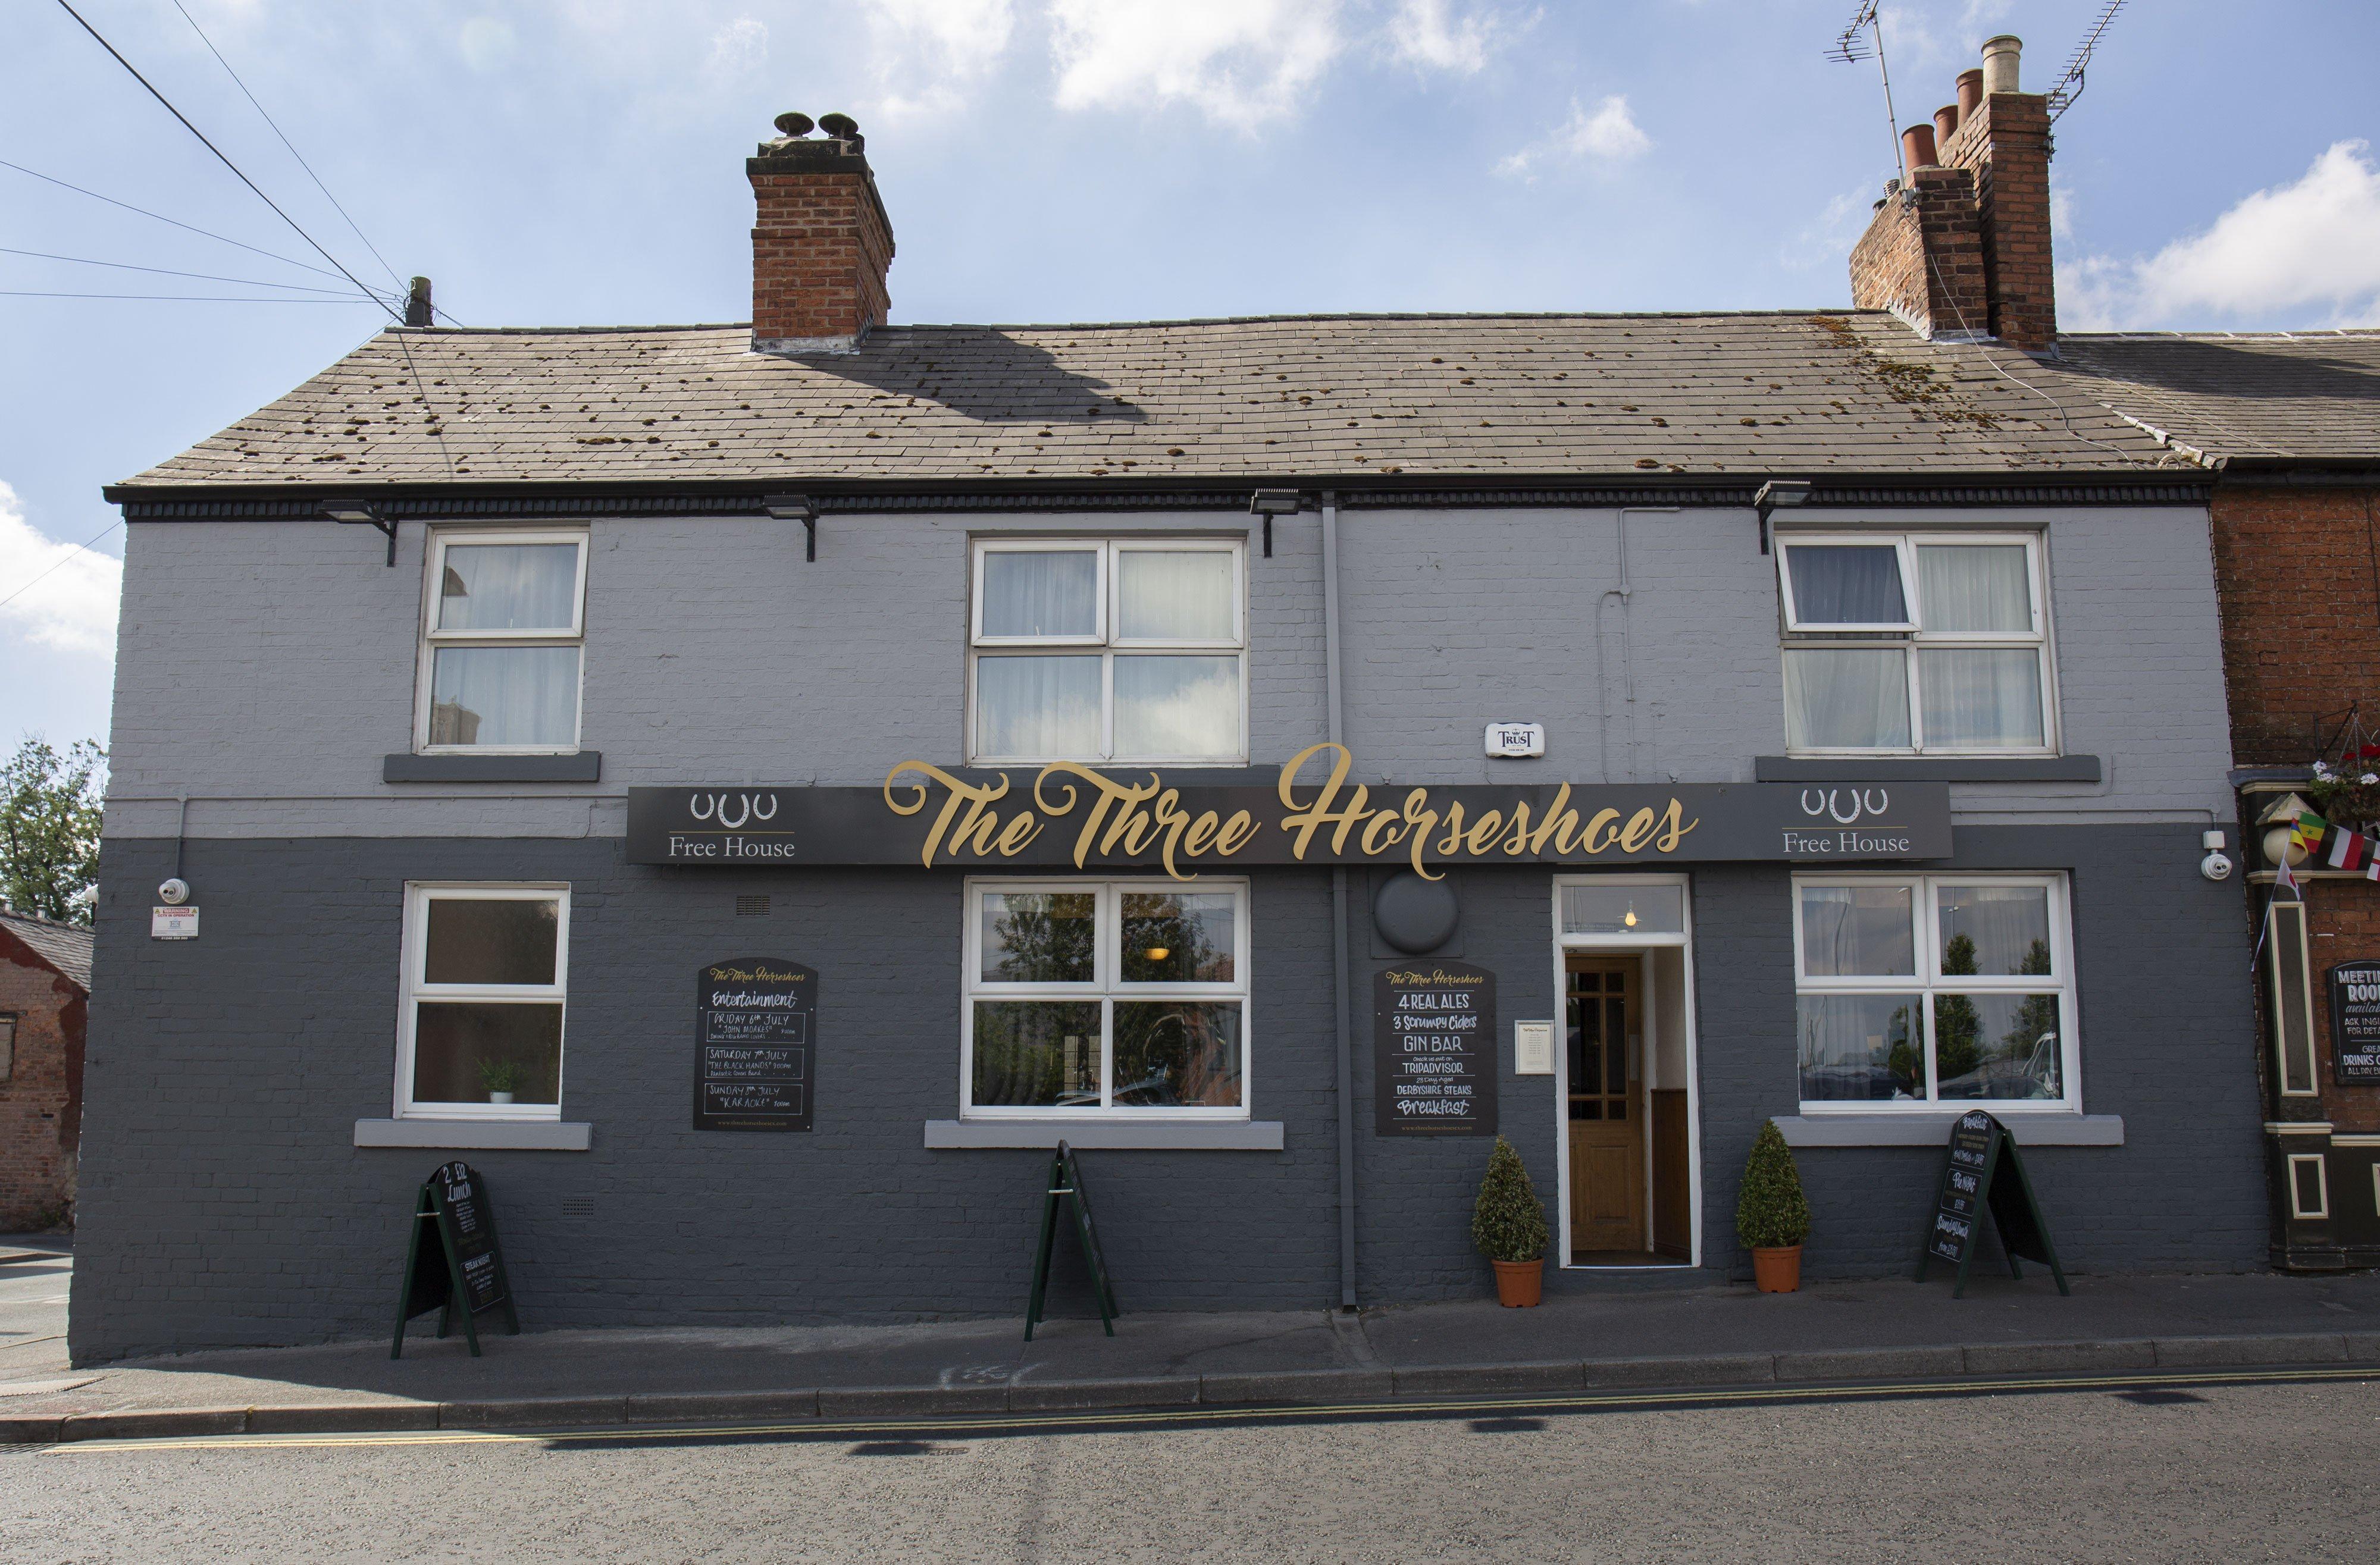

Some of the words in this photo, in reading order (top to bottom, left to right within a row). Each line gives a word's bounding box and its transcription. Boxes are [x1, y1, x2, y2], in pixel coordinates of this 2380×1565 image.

[1497, 731, 1535, 747] TRUST
[884, 760, 1045, 869] The
[1034, 760, 1261, 881] Three
[1278, 742, 1699, 880] Horseshoes
[668, 836, 716, 856] Free
[724, 837, 795, 857] House
[1782, 833, 1831, 852] Free
[1838, 832, 1910, 852] House
[710, 968, 728, 981] The
[728, 968, 754, 983] Three
[756, 967, 807, 984] Horseshoes
[1386, 971, 1405, 985] The
[1404, 971, 1431, 987] Three
[1433, 969, 1483, 987] Horseshoes
[712, 990, 798, 1008] Entertainment
[1398, 995, 1410, 1009] 4
[1411, 995, 1439, 1009] REAL
[1440, 994, 1470, 1009] ALES
[714, 1013, 746, 1024] FRIDAY
[764, 1014, 789, 1025] JULY
[1393, 1016, 1401, 1030] 3
[1404, 1015, 1447, 1030] Scrumpy
[1449, 1015, 1477, 1030] Ciders
[2347, 1027, 2362, 1035] FOR
[1404, 1036, 1427, 1052] GIN
[1432, 1036, 1463, 1052] BAR
[710, 1049, 751, 1059] SATURDAY
[765, 1050, 788, 1061] JULY
[2343, 1055, 2375, 1065] DRINKS
[724, 1061, 744, 1069] BLACK
[1402, 1062, 1464, 1074] TRIPADVISOR
[710, 1085, 744, 1096] SUNDAY
[758, 1086, 780, 1096] JULY
[1397, 1085, 1442, 1095] DERBYSHIRE
[1443, 1085, 1472, 1095] STEAKS
[1397, 1099, 1470, 1116] Breakfast
[443, 1166, 452, 1184] 2
[447, 1181, 472, 1202] Lunch
